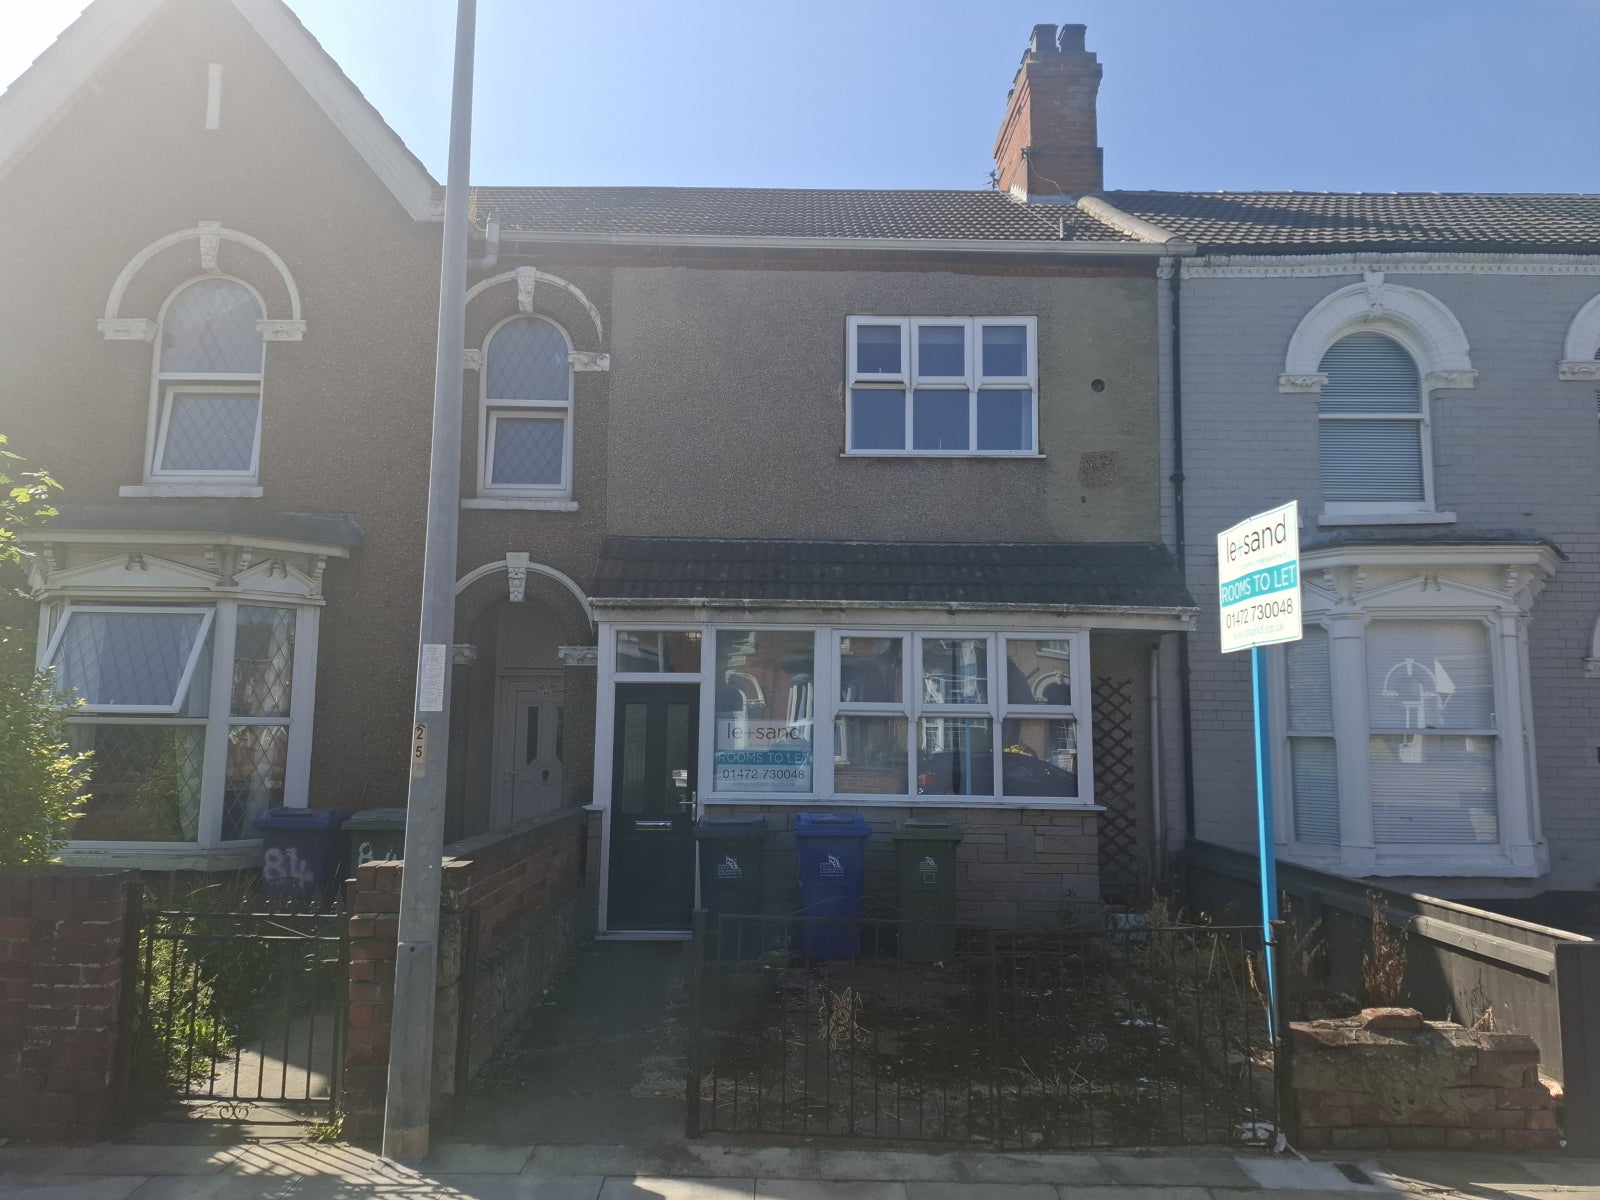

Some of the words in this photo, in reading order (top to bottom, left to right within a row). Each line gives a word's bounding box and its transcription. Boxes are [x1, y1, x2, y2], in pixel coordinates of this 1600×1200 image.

[1222, 578, 1251, 603] ROOMS
[1253, 572, 1271, 593] TO
[1274, 565, 1296, 588] LET
[1226, 608, 1249, 628] 01472
[1251, 598, 1293, 622] 730048
[718, 752, 763, 763] ROOMS
[768, 752, 785, 763] TO
[722, 769, 759, 780] 01472
[763, 769, 805, 780] 730048
